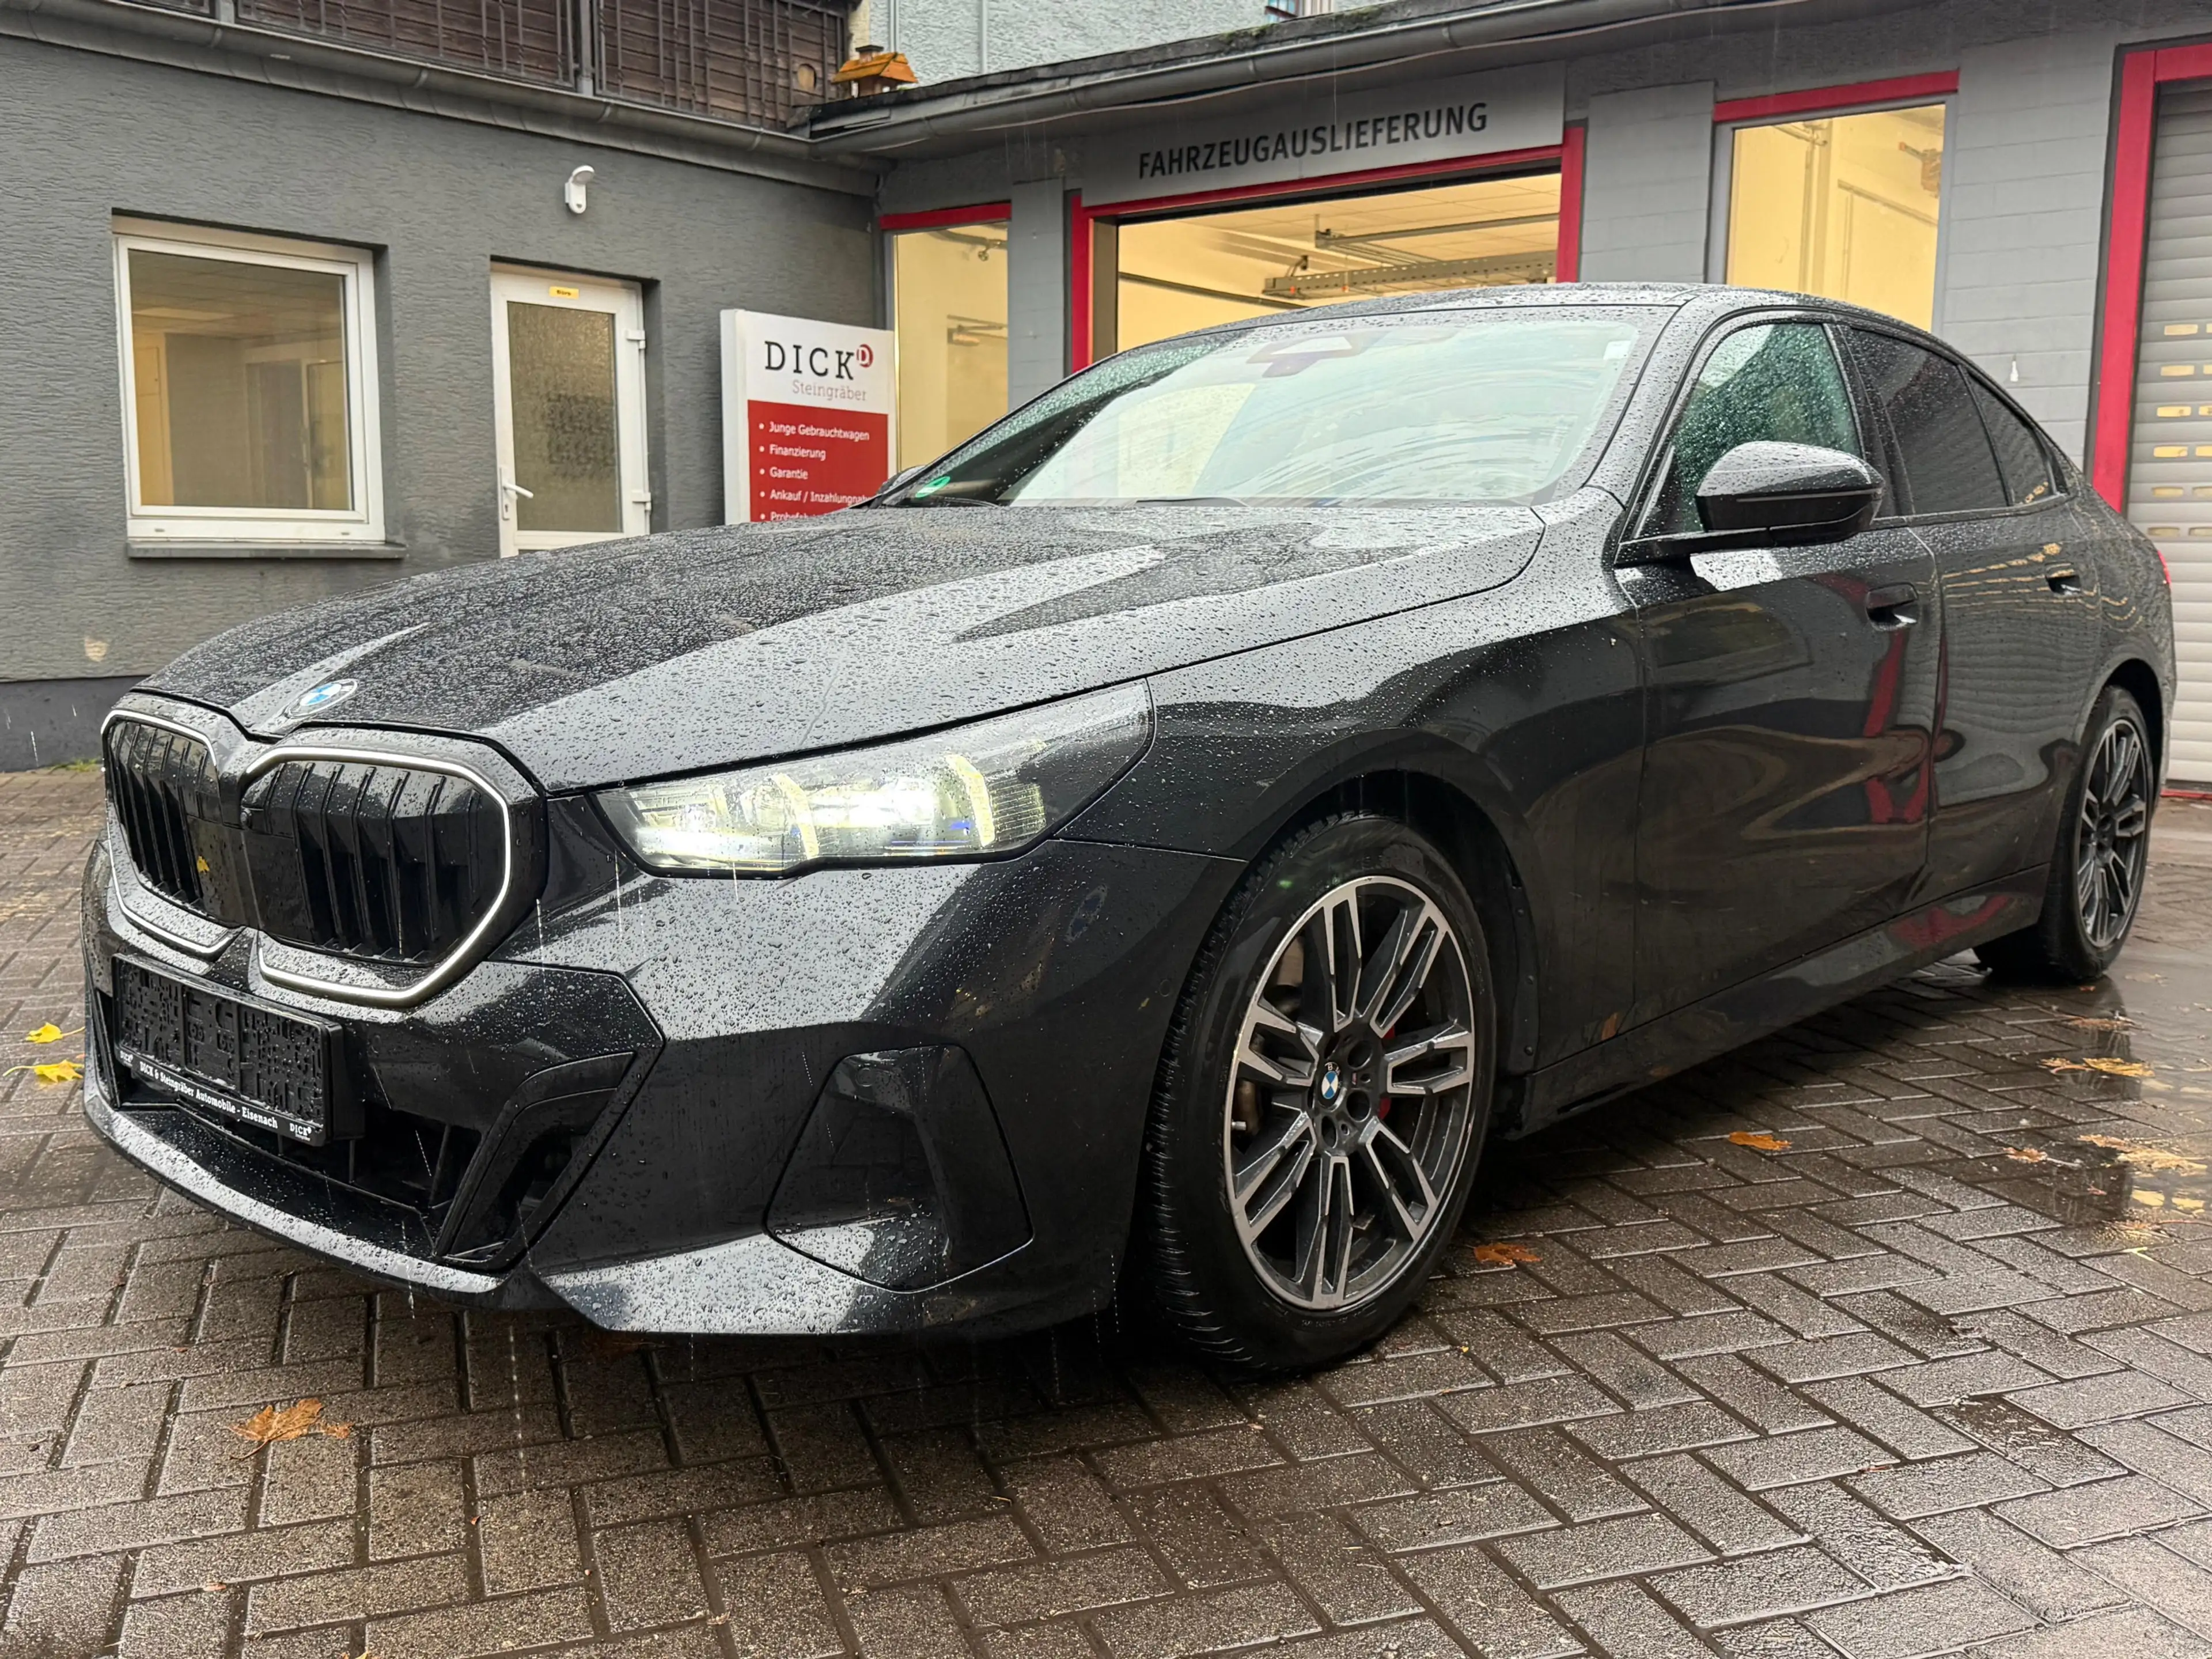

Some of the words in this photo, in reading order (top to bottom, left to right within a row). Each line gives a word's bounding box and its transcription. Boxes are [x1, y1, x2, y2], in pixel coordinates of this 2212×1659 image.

[1139, 103, 1487, 178] FAHRZEUGAUSLIEFERUNG
[764, 340, 854, 380] DICK
[792, 379, 867, 400] Steingräber
[770, 422, 796, 435] Junge
[798, 424, 869, 442] Gebrauchtwagen
[770, 444, 825, 461] Finanzierung
[770, 467, 808, 479] Garantie
[770, 489, 802, 501] Ankauf
[803, 492, 808, 503] /
[196, 1089, 236, 1113] Automobile
[241, 1107, 278, 1128] Eisenach
